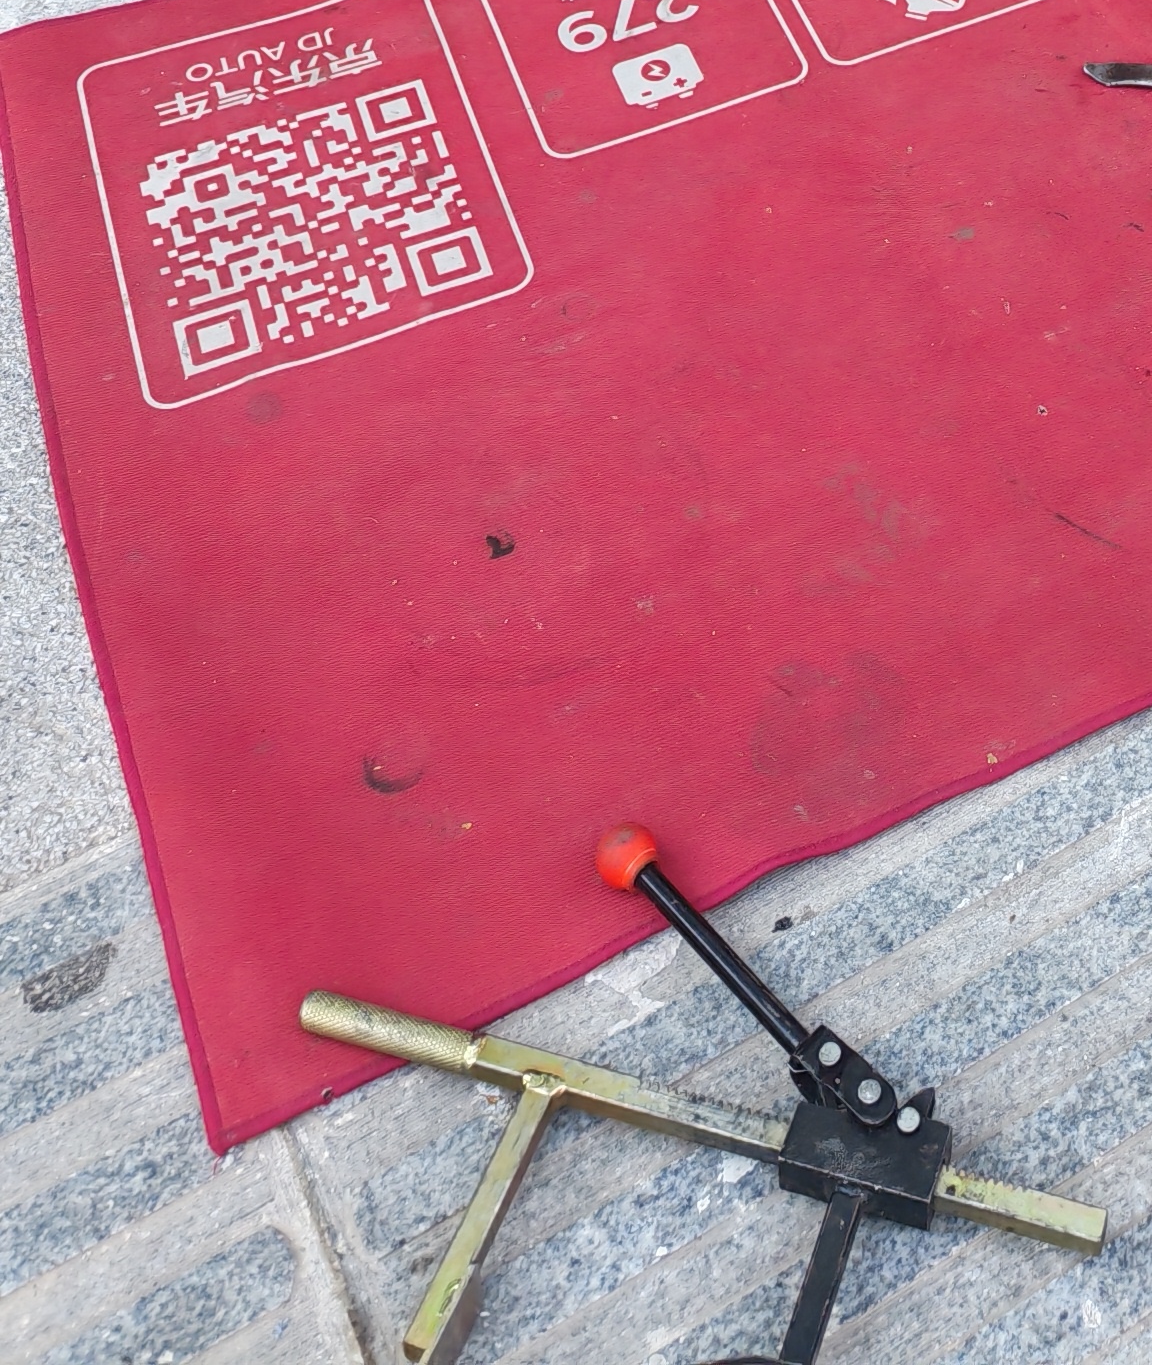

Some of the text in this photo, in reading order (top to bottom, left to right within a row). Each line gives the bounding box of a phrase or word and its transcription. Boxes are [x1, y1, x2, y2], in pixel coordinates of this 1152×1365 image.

[154, 38, 383, 127] 京东汽车
[186, 27, 334, 82] JD AUTO
